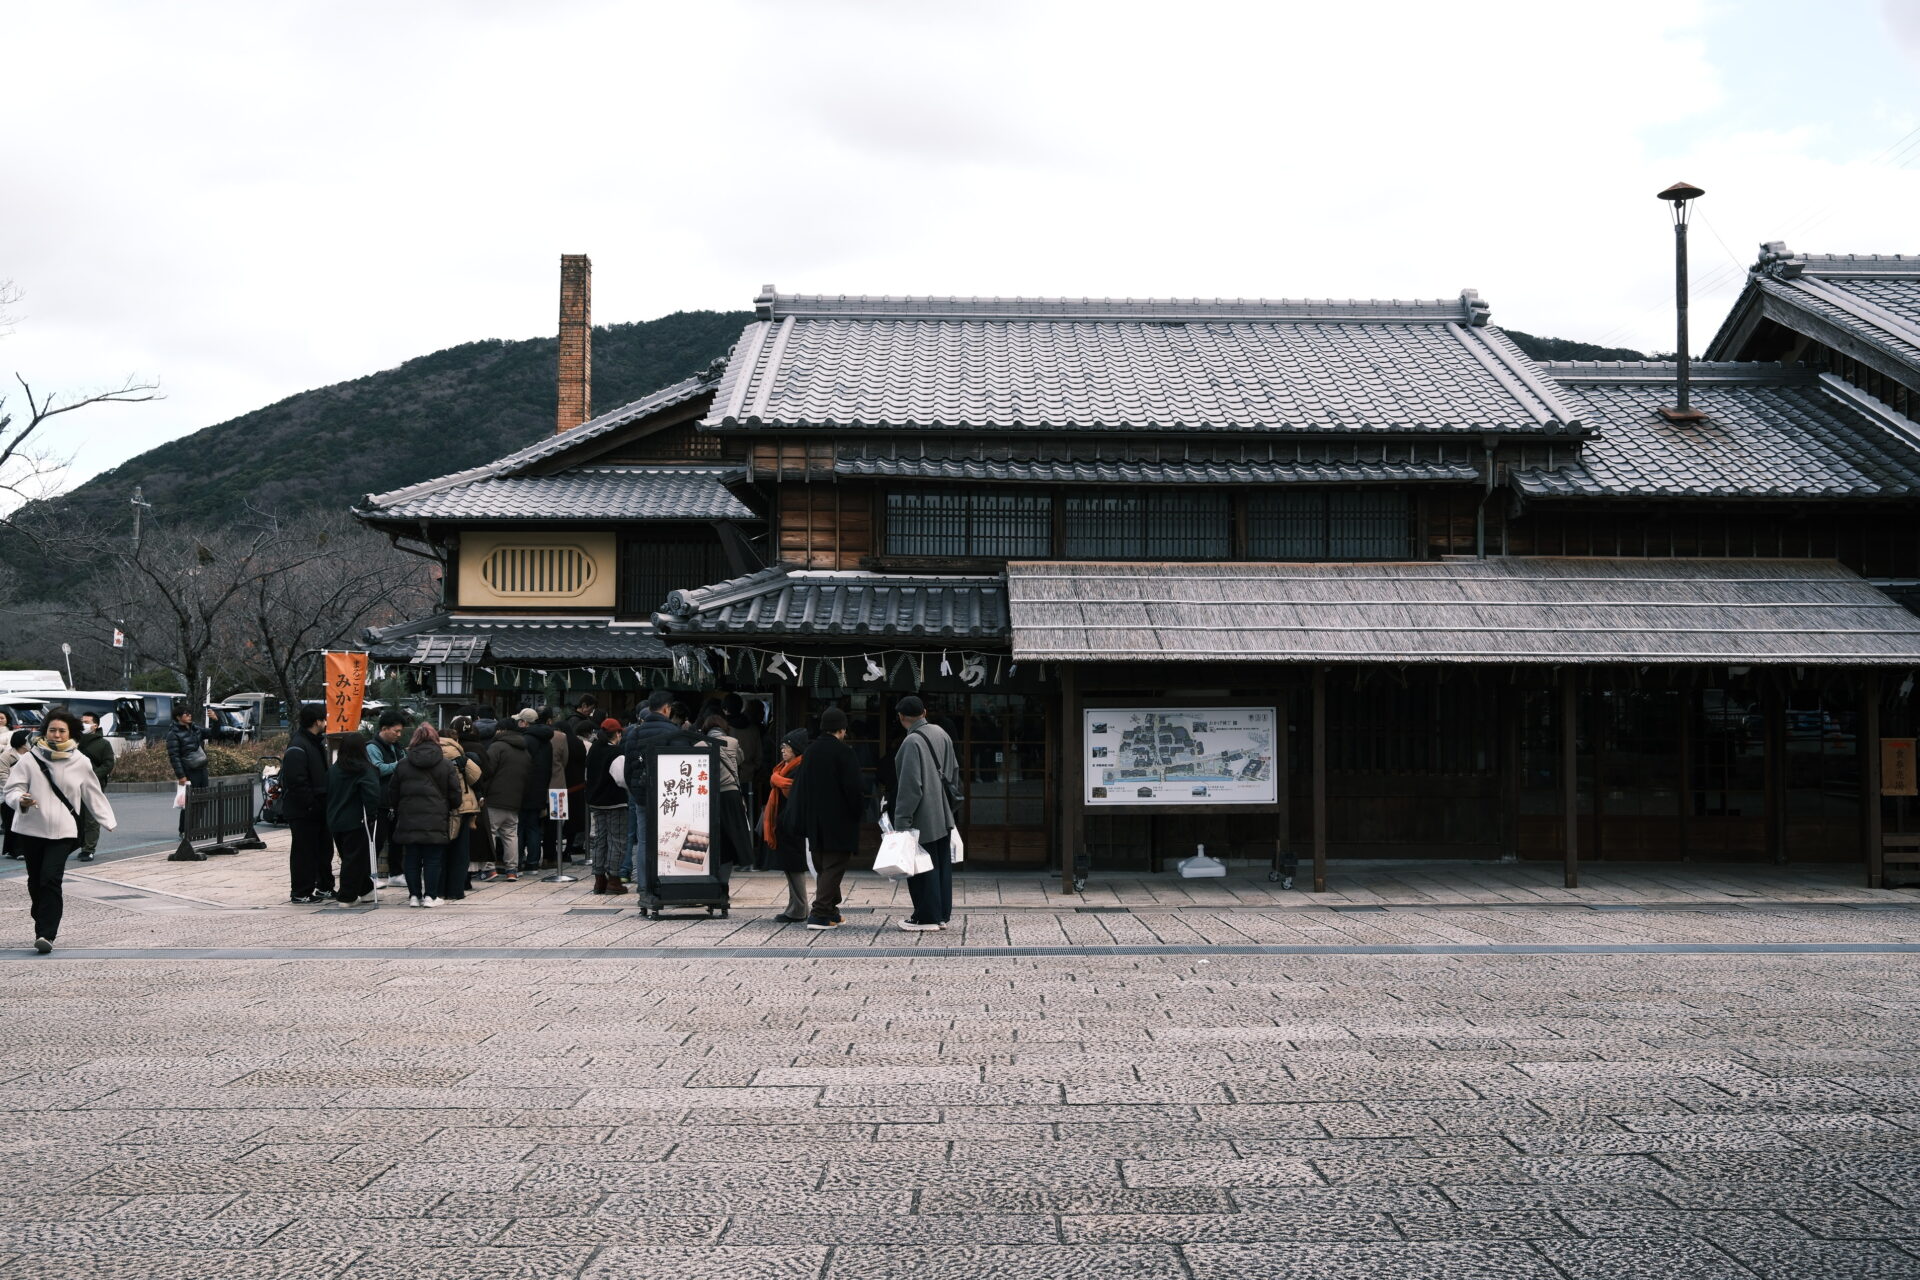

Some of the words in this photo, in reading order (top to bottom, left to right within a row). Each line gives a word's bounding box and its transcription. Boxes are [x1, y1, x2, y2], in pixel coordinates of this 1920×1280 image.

[352, 660, 361, 696] まるごと
[675, 760, 695, 798] 白餅
[697, 770, 708, 796] 赤福
[659, 779, 680, 817] 黒餅
